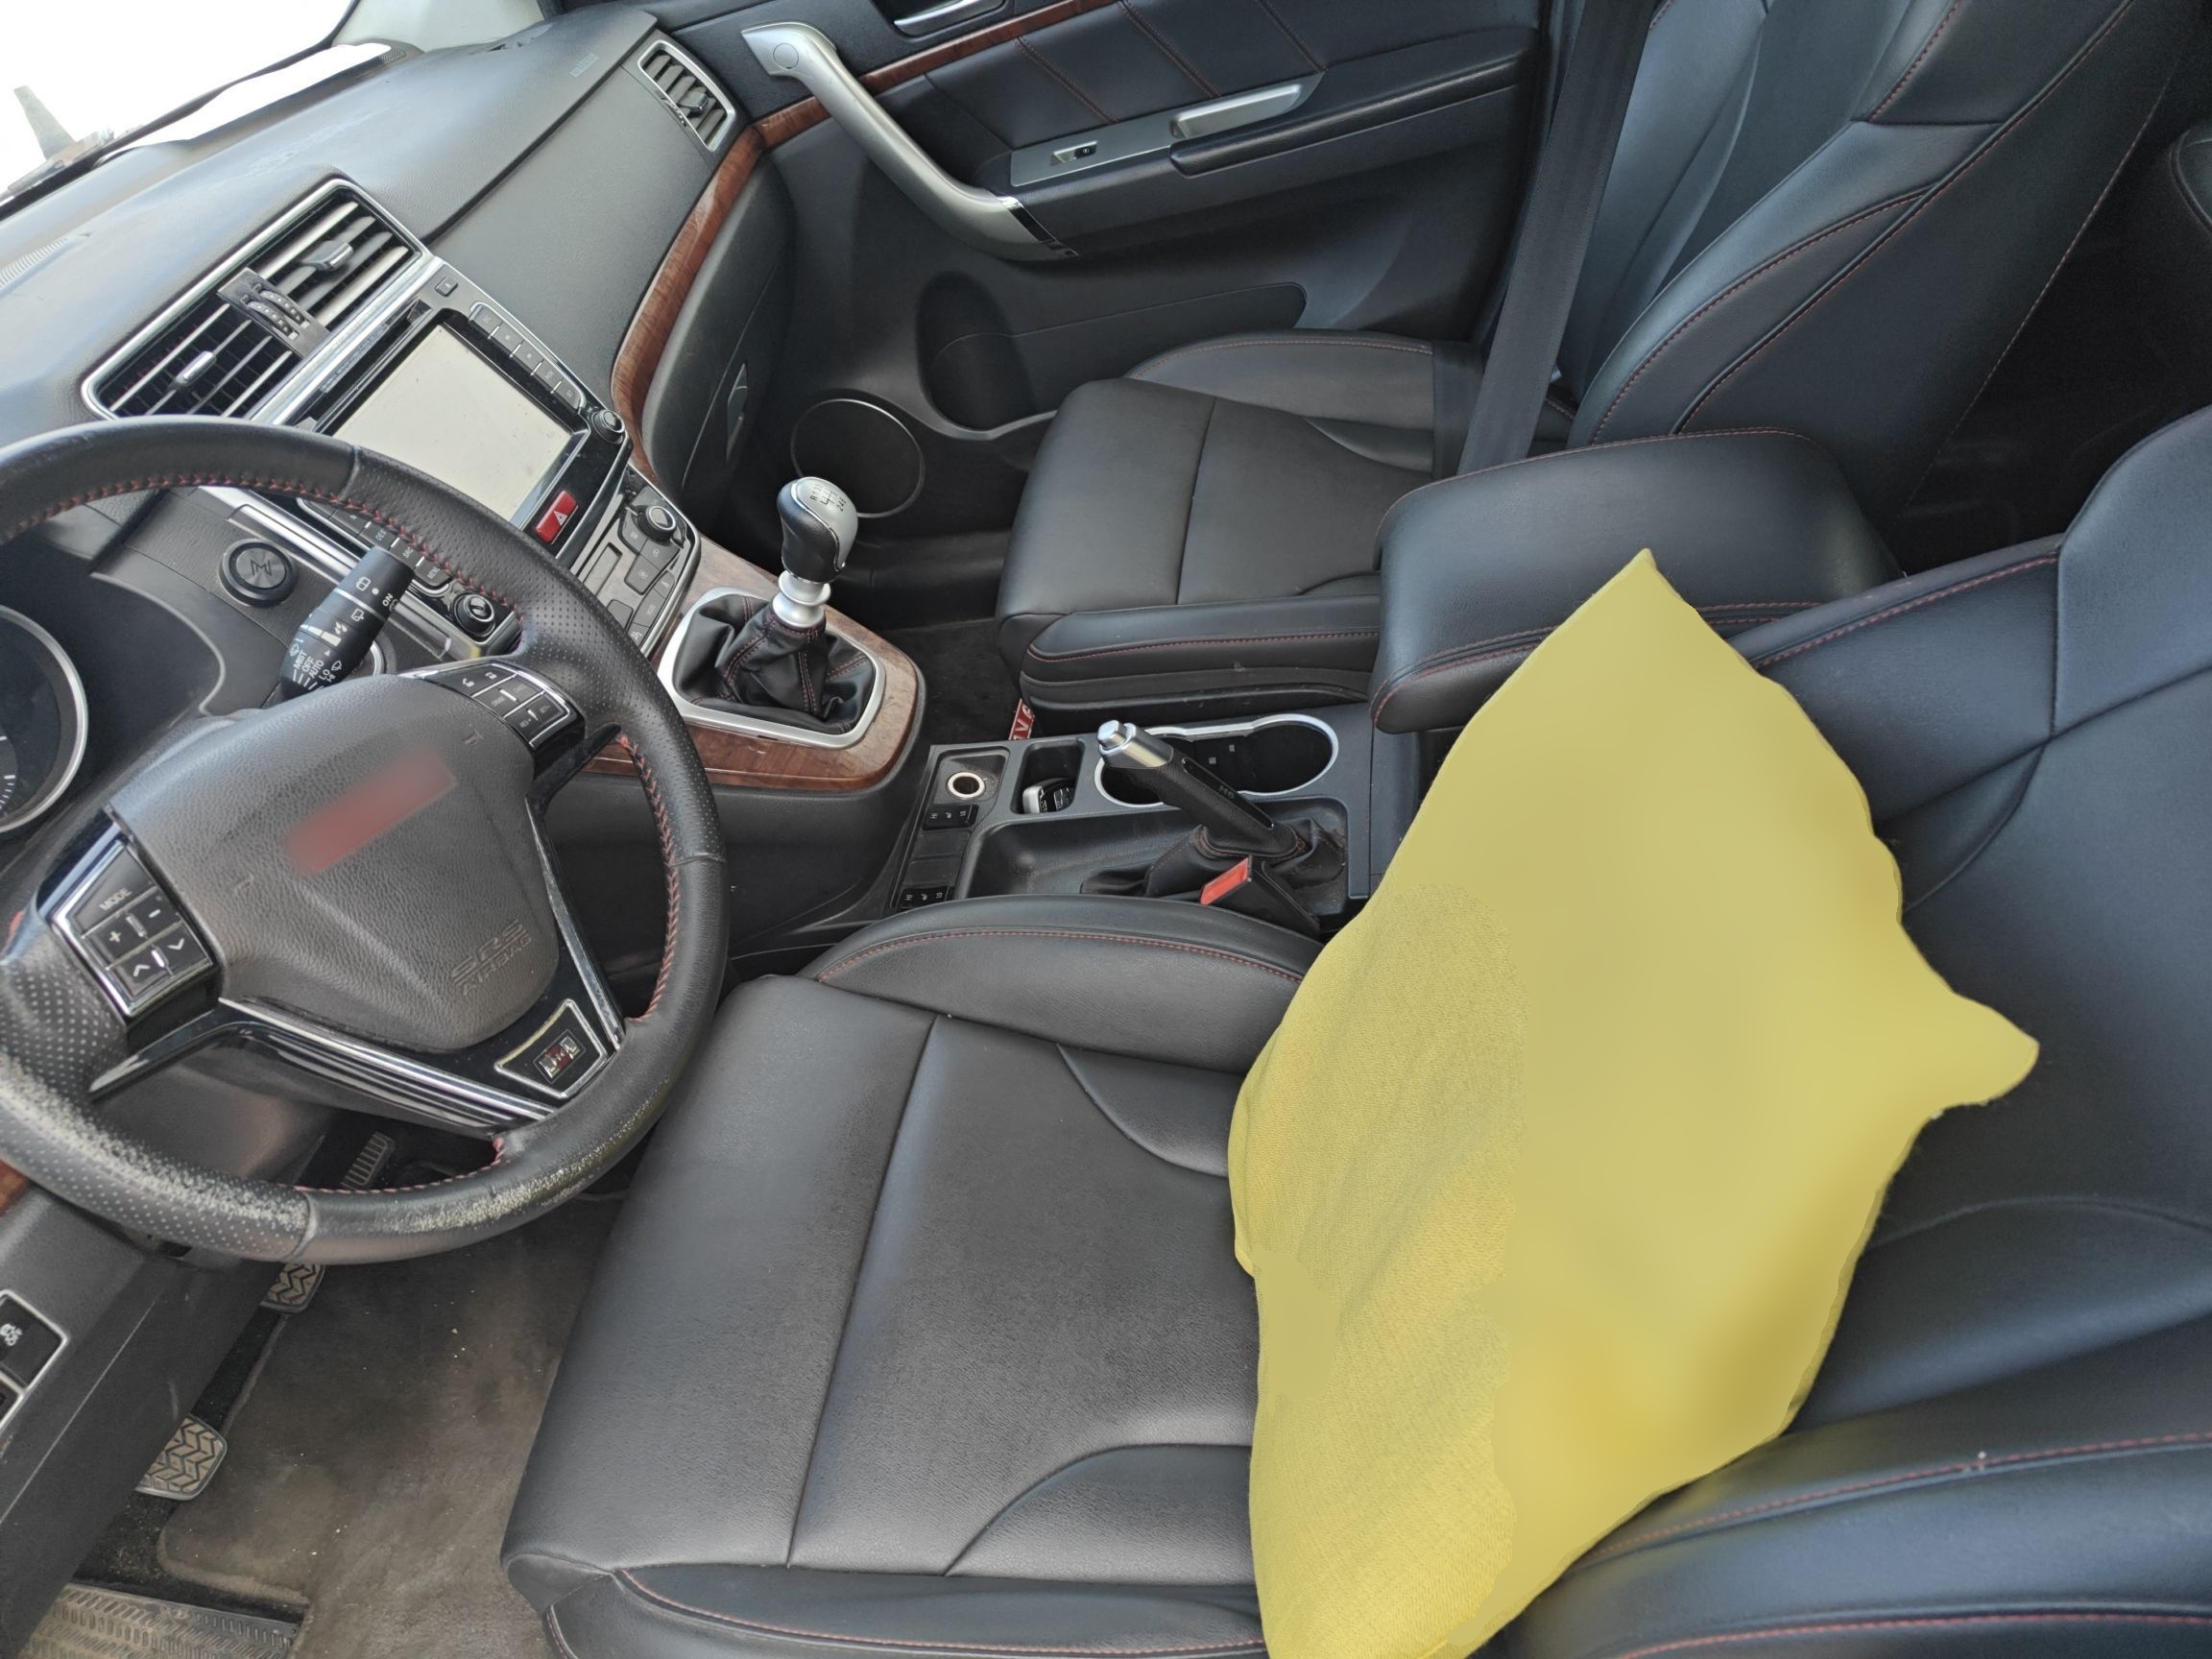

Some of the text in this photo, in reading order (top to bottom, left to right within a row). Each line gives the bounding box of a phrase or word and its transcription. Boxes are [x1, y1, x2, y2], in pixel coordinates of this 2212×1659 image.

[382, 592, 394, 607] ON
[293, 649, 307, 670] MIST
[301, 656, 315, 673] OFF
[309, 660, 325, 679] AUTO
[319, 669, 330, 681] LO
[99, 888, 132, 911] MODE
[449, 918, 525, 983] SRS
